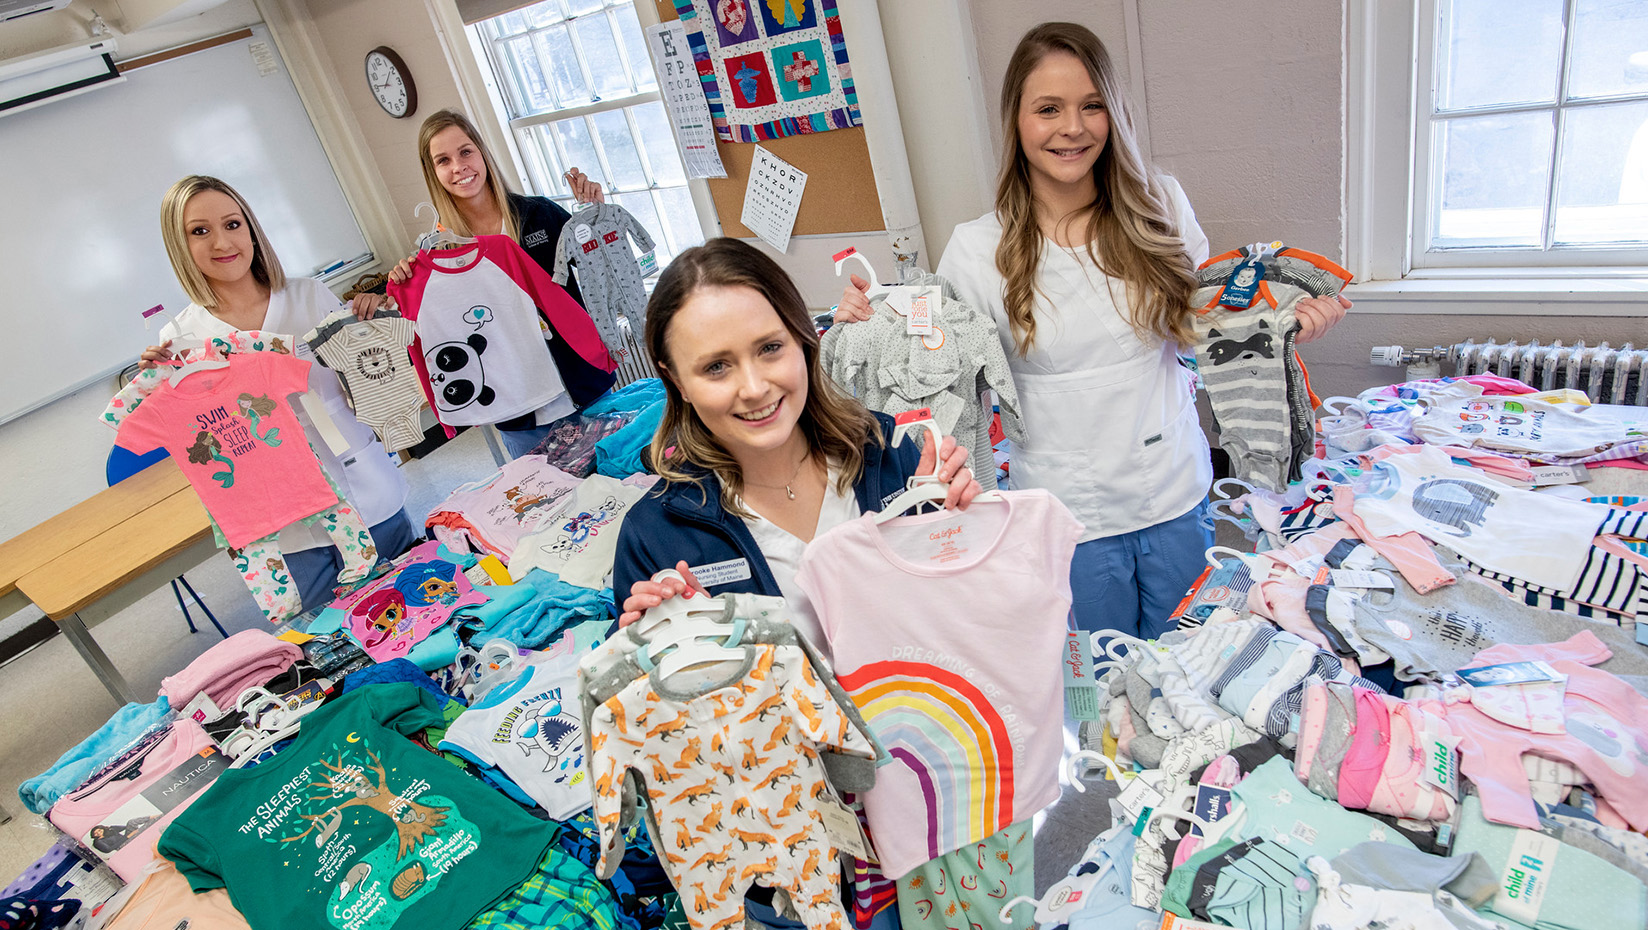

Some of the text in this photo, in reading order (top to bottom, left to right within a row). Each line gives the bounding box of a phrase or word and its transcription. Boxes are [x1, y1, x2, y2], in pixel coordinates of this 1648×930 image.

[658, 30, 677, 58] E
[390, 66, 396, 75] 2
[396, 77, 402, 86] 3
[394, 103, 400, 111] 6
[398, 98, 404, 107] 5
[640, 254, 655, 267] child
[912, 312, 927, 320] you
[196, 406, 229, 430] SWIM
[211, 417, 240, 435] Splash
[223, 426, 249, 448] SLEEP
[232, 440, 257, 457] REPEAT
[947, 526, 962, 539] Jack
[712, 561, 745, 571] Hammond
[1440, 611, 1468, 642] HAPPY
[1068, 640, 1080, 652] Cat
[892, 645, 975, 678] DREAMING
[984, 681, 1000, 699] OF
[1066, 660, 1085, 679] Jack
[491, 687, 562, 743] FEEDING FRENZY
[329, 764, 351, 782] Koala
[1433, 741, 1447, 784] child
[162, 759, 216, 796] NAUTICA
[238, 766, 312, 834] THE SLEEPIEST
[389, 778, 418, 806] Squirrel
[406, 783, 430, 803] hours)
[1129, 788, 1150, 810] carter's
[258, 794, 302, 839] ANIMALS
[1207, 795, 1220, 823] rshalls
[318, 841, 335, 864] Sloth
[419, 838, 443, 858] Giant
[429, 830, 464, 861] Armadillo
[432, 834, 472, 868] South America
[324, 845, 356, 882] (12 hours)
[439, 841, 478, 873] (19 hours)
[1504, 868, 1525, 898] child
[1524, 875, 1537, 896] mine
[362, 897, 387, 921] hours)
